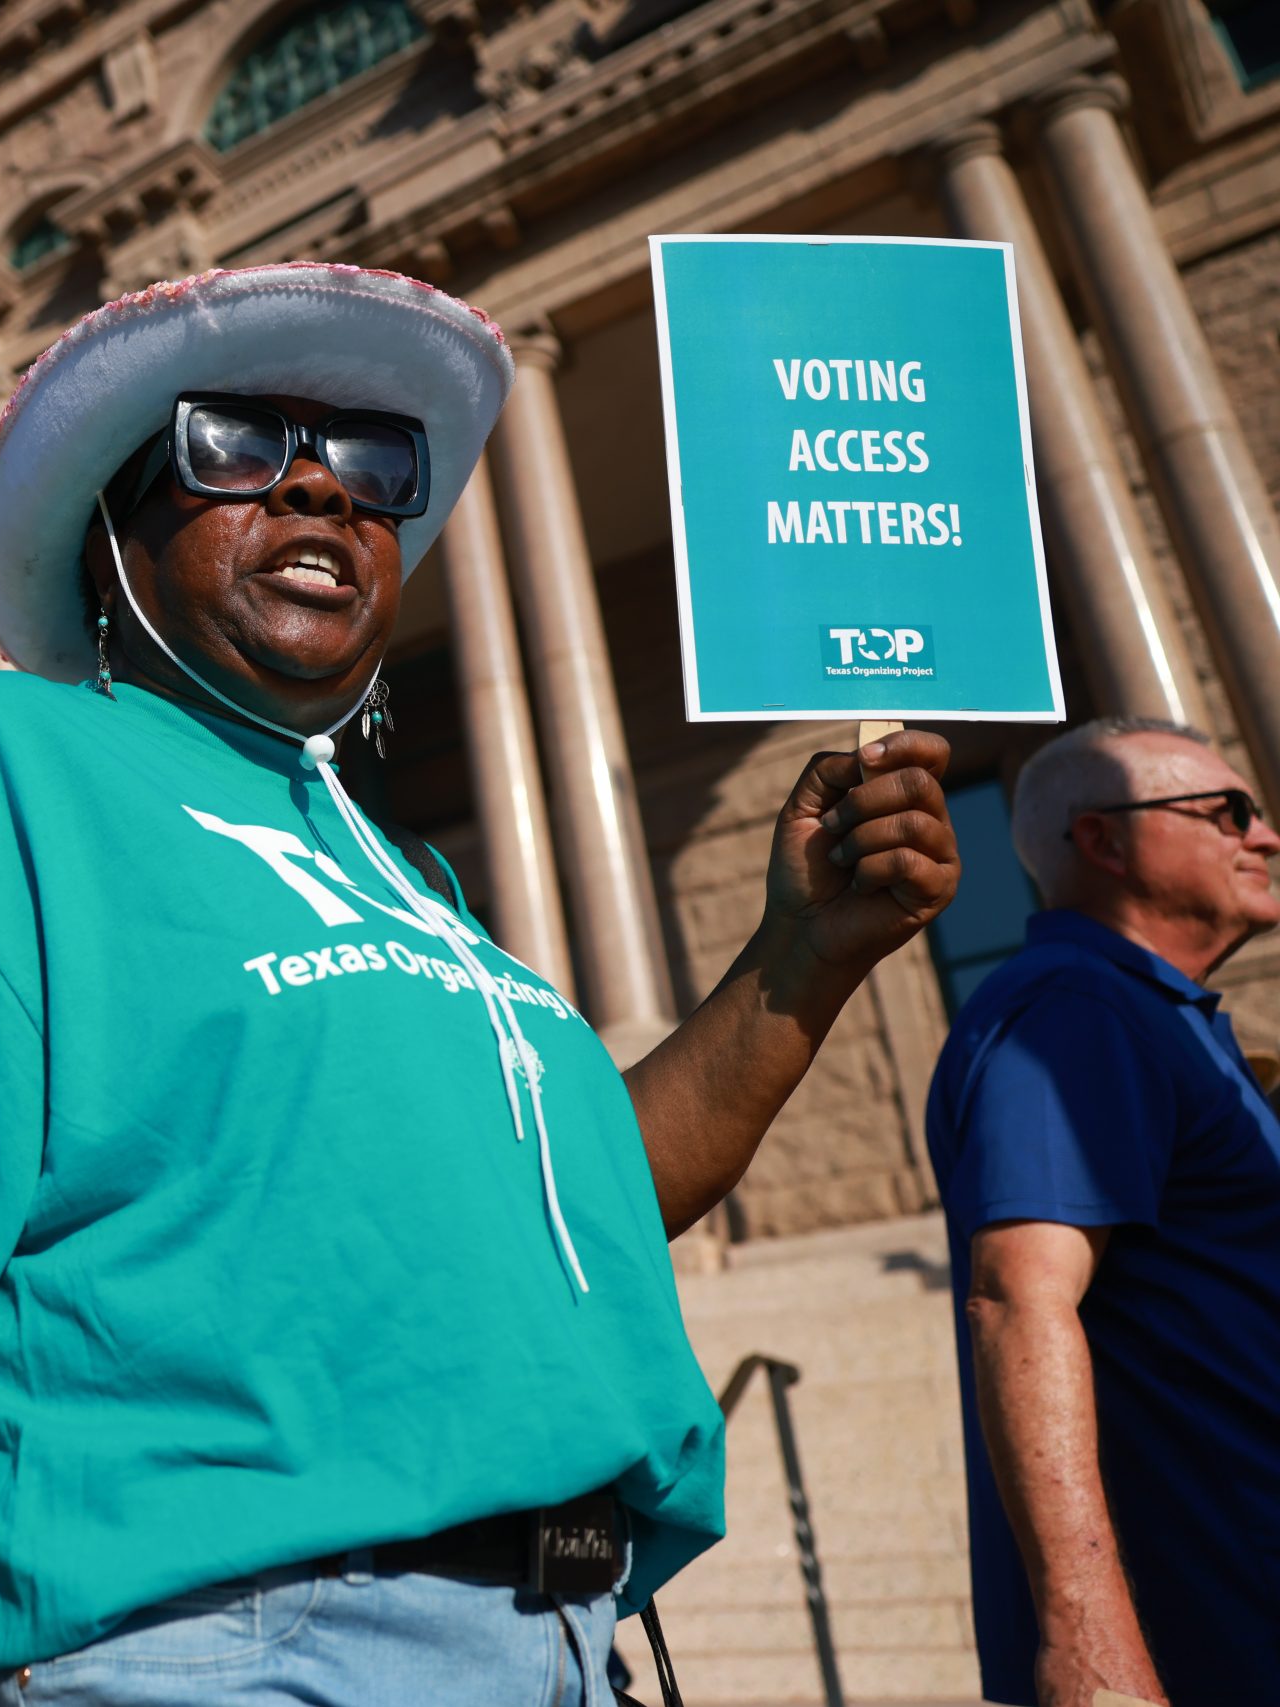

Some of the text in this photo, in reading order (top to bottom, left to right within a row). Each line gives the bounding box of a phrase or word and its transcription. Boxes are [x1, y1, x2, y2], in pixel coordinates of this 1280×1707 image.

[772, 358, 926, 402] VOTING
[788, 429, 930, 473] ACCESS
[766, 500, 963, 547] MATTERS!
[829, 628, 924, 665] TOP
[825, 666, 934, 677] Texas Organizing Project
[243, 942, 388, 995] Texas
[386, 940, 569, 1020] Orgazing
